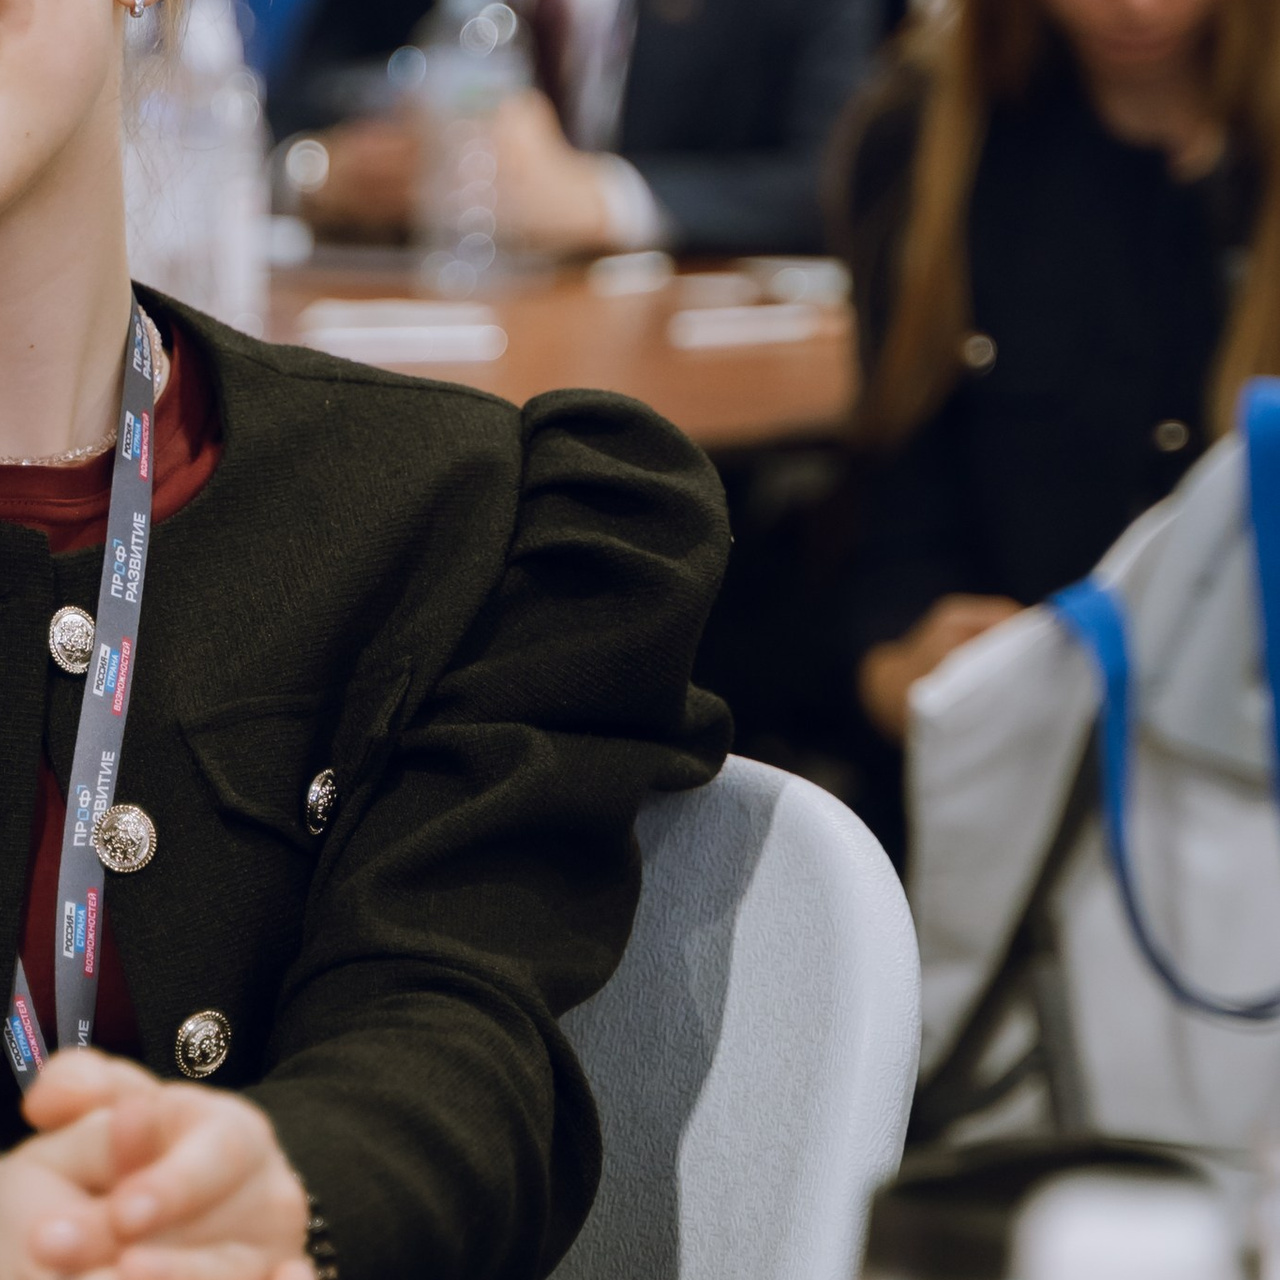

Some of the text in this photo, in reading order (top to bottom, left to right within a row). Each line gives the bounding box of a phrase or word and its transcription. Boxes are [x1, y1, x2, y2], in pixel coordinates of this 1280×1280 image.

[123, 423, 132, 456] РОССИЯ
[133, 423, 141, 454] СТРАНА
[140, 412, 149, 478] ВОЗМОЖНОСТЕЙ
[125, 512, 146, 603] РАЗВИТИЕ
[95, 656, 107, 692] РОССИЯ
[107, 654, 119, 688] СТРАНА
[113, 641, 131, 712] ВОЗМОЖНОСТЕЙ
[64, 914, 74, 953] РОССИЯ
[76, 909, 85, 947] СТРАНА
[85, 892, 97, 973] ВОЗМОЖНОСТЕЙ
[13, 1019, 31, 1057] СТРАНА
[16, 1000, 45, 1072] ОЗМОЖНОСТЕЙ
